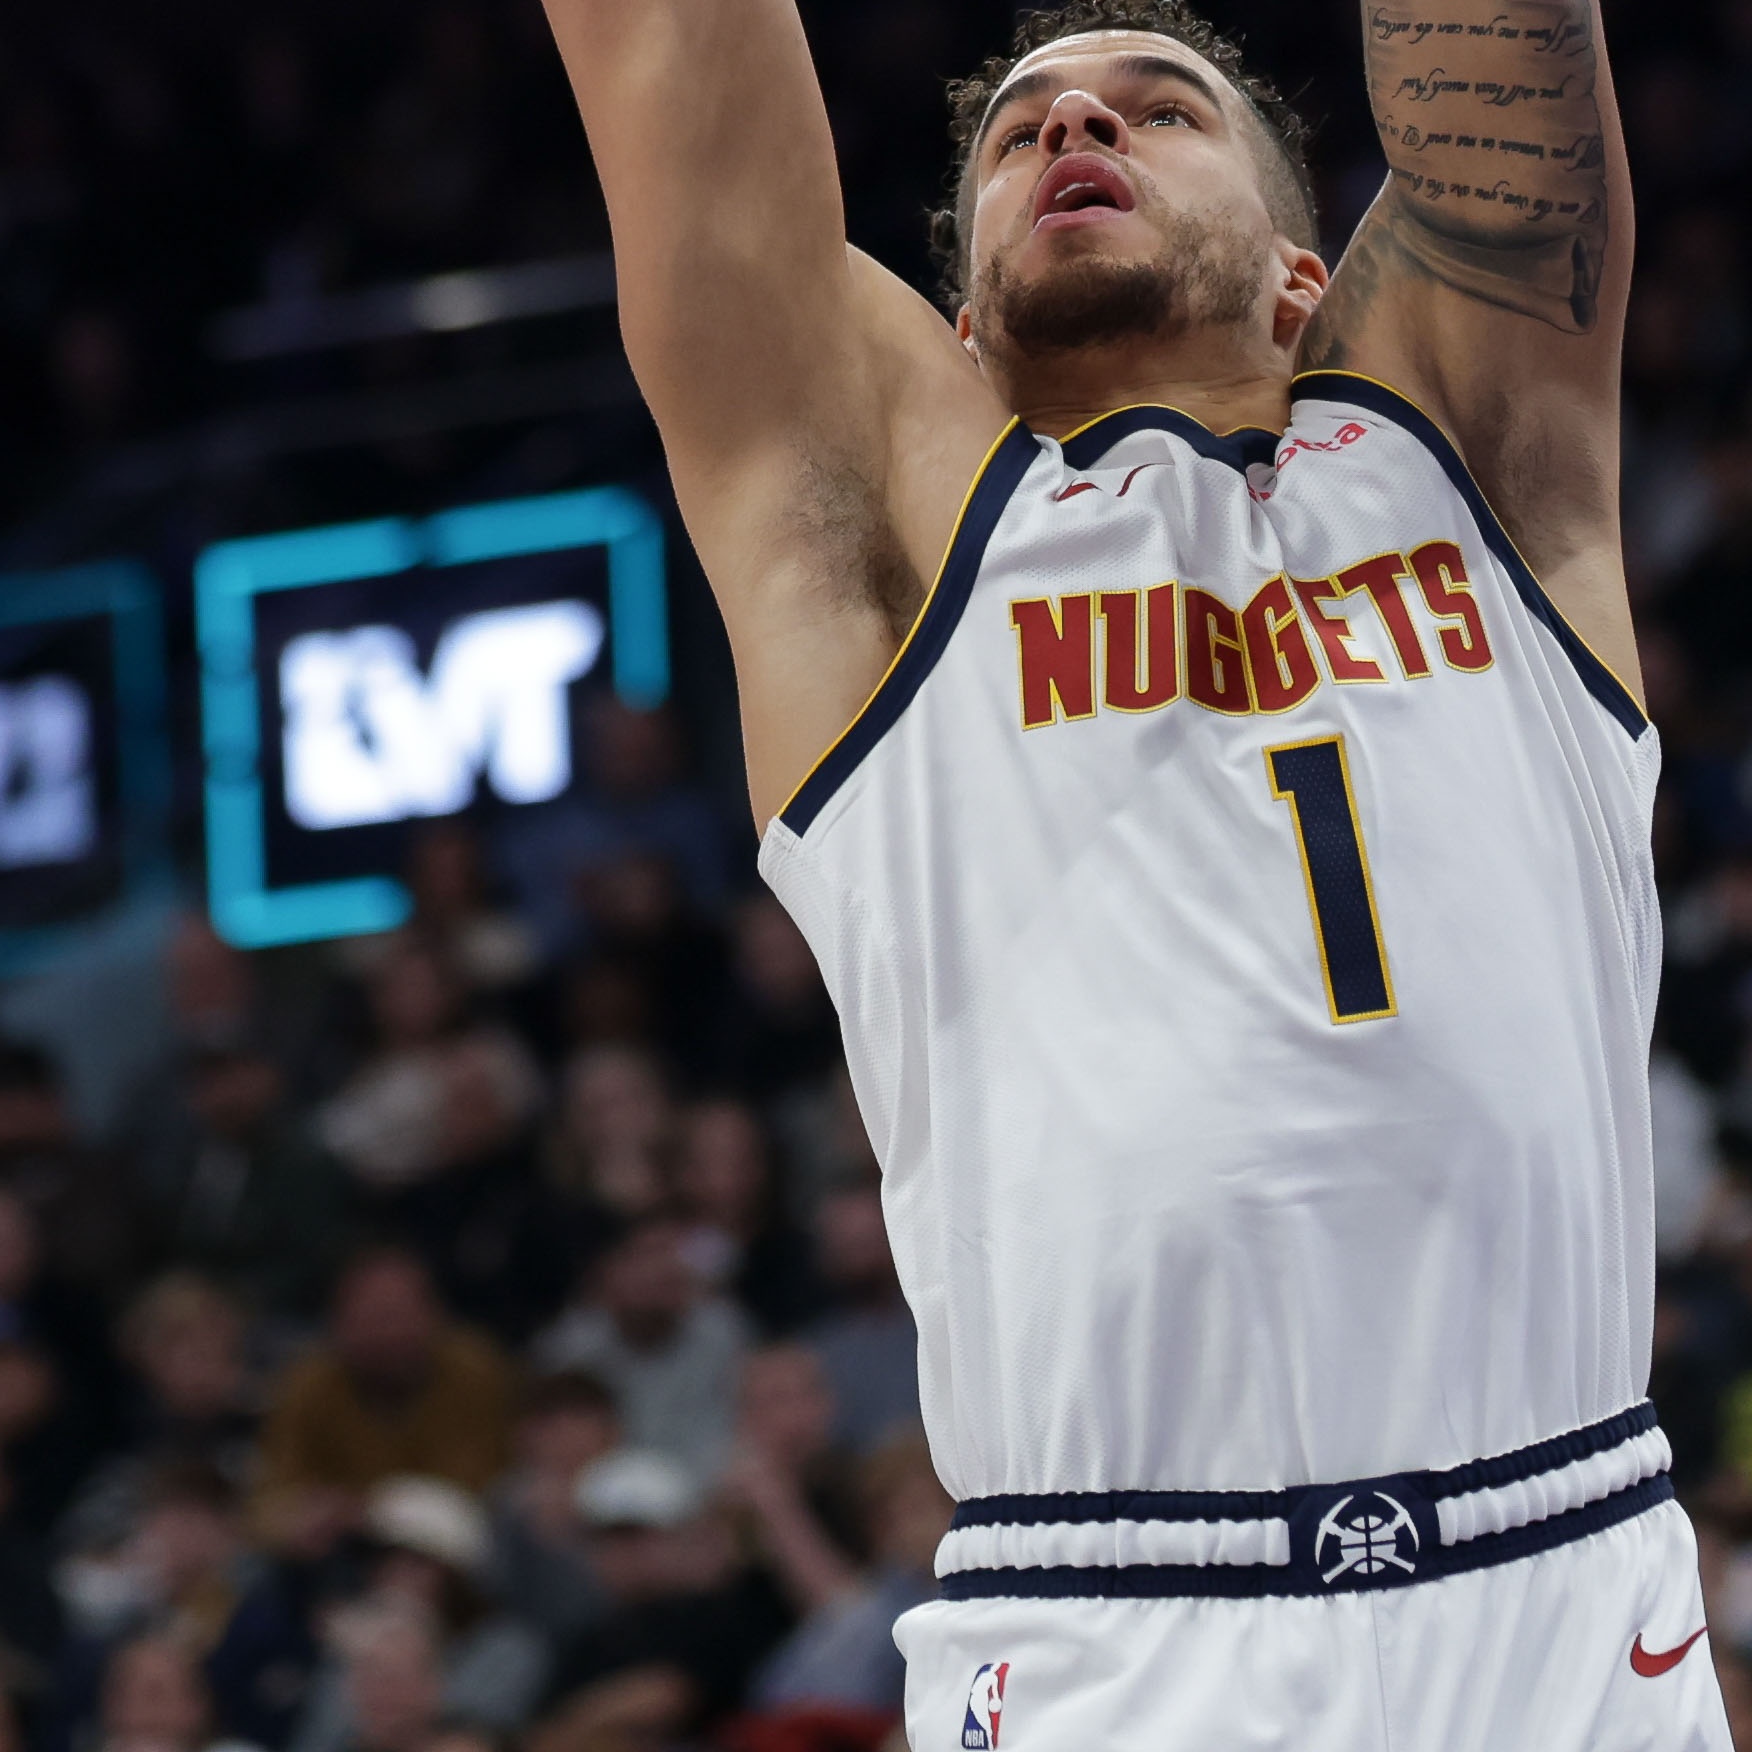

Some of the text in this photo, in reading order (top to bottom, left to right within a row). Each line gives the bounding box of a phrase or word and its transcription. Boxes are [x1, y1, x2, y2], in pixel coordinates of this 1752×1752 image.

[1008, 537, 1496, 732] NUGGETS
[1263, 732, 1400, 1026] 1
[965, 1728, 985, 1748] NBA
